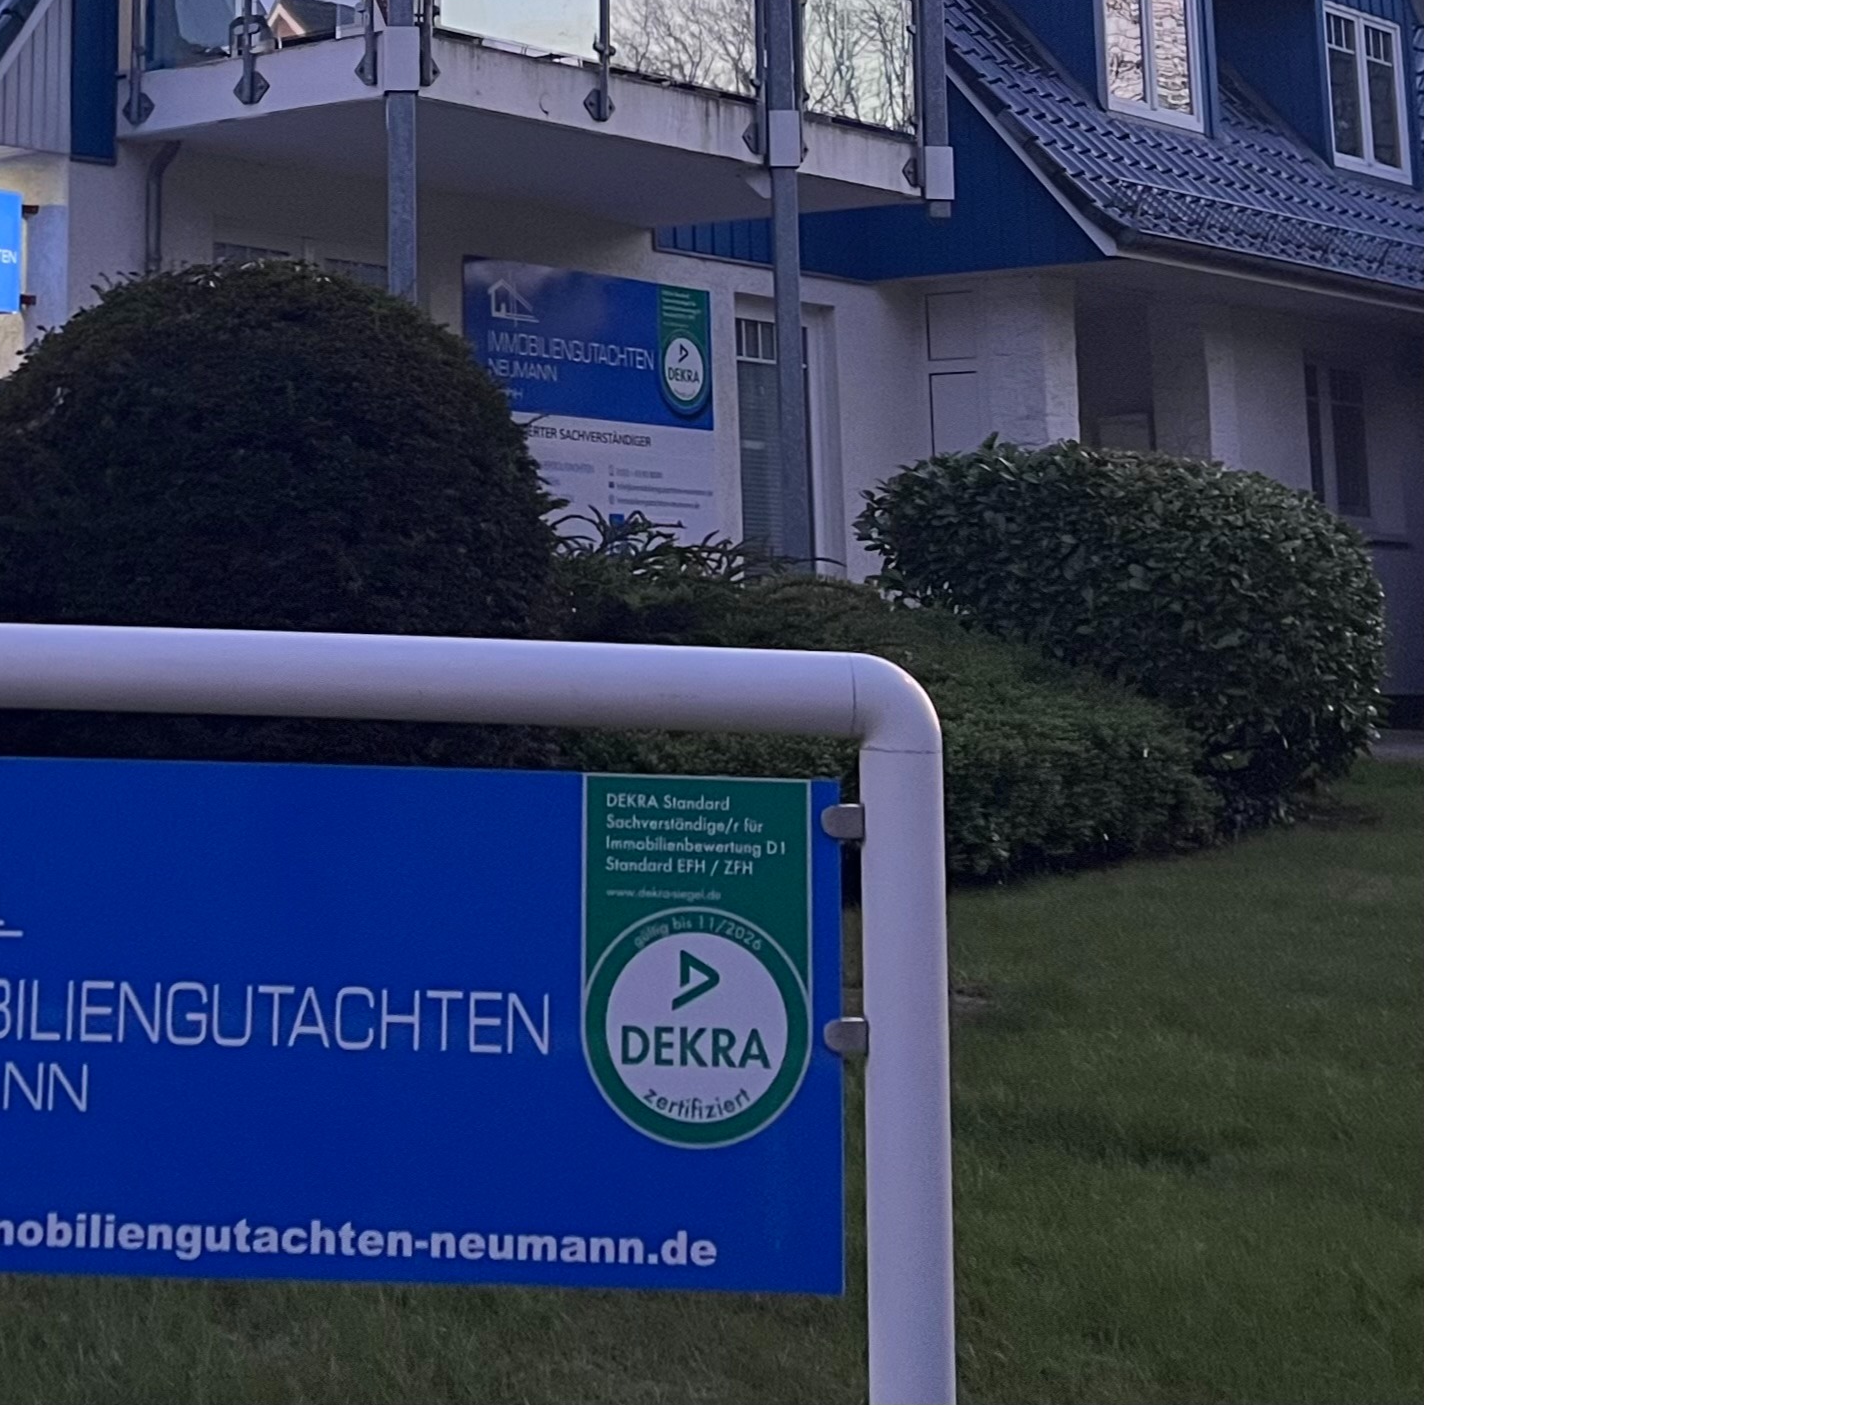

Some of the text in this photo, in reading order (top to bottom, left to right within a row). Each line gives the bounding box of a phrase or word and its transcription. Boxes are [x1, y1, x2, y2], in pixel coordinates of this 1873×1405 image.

[487, 329, 655, 371] IMMOBILIENGUTACHTEN
[488, 357, 558, 382] NEUMANN
[668, 367, 700, 383] DEKRA
[559, 428, 652, 447] SACHVERSTÄNDIGER
[606, 793, 730, 811] DEKRA Standard
[606, 813, 763, 836] Sachverständige/r für
[605, 835, 761, 857] Immobilienbewertung
[605, 856, 672, 873] Standard
[677, 858, 706, 874] EFH
[723, 859, 754, 875] ZFH
[634, 915, 763, 951] gültig bis 11/2026
[621, 1024, 772, 1070] DEKRA
[643, 1087, 751, 1120] zertifiziert
